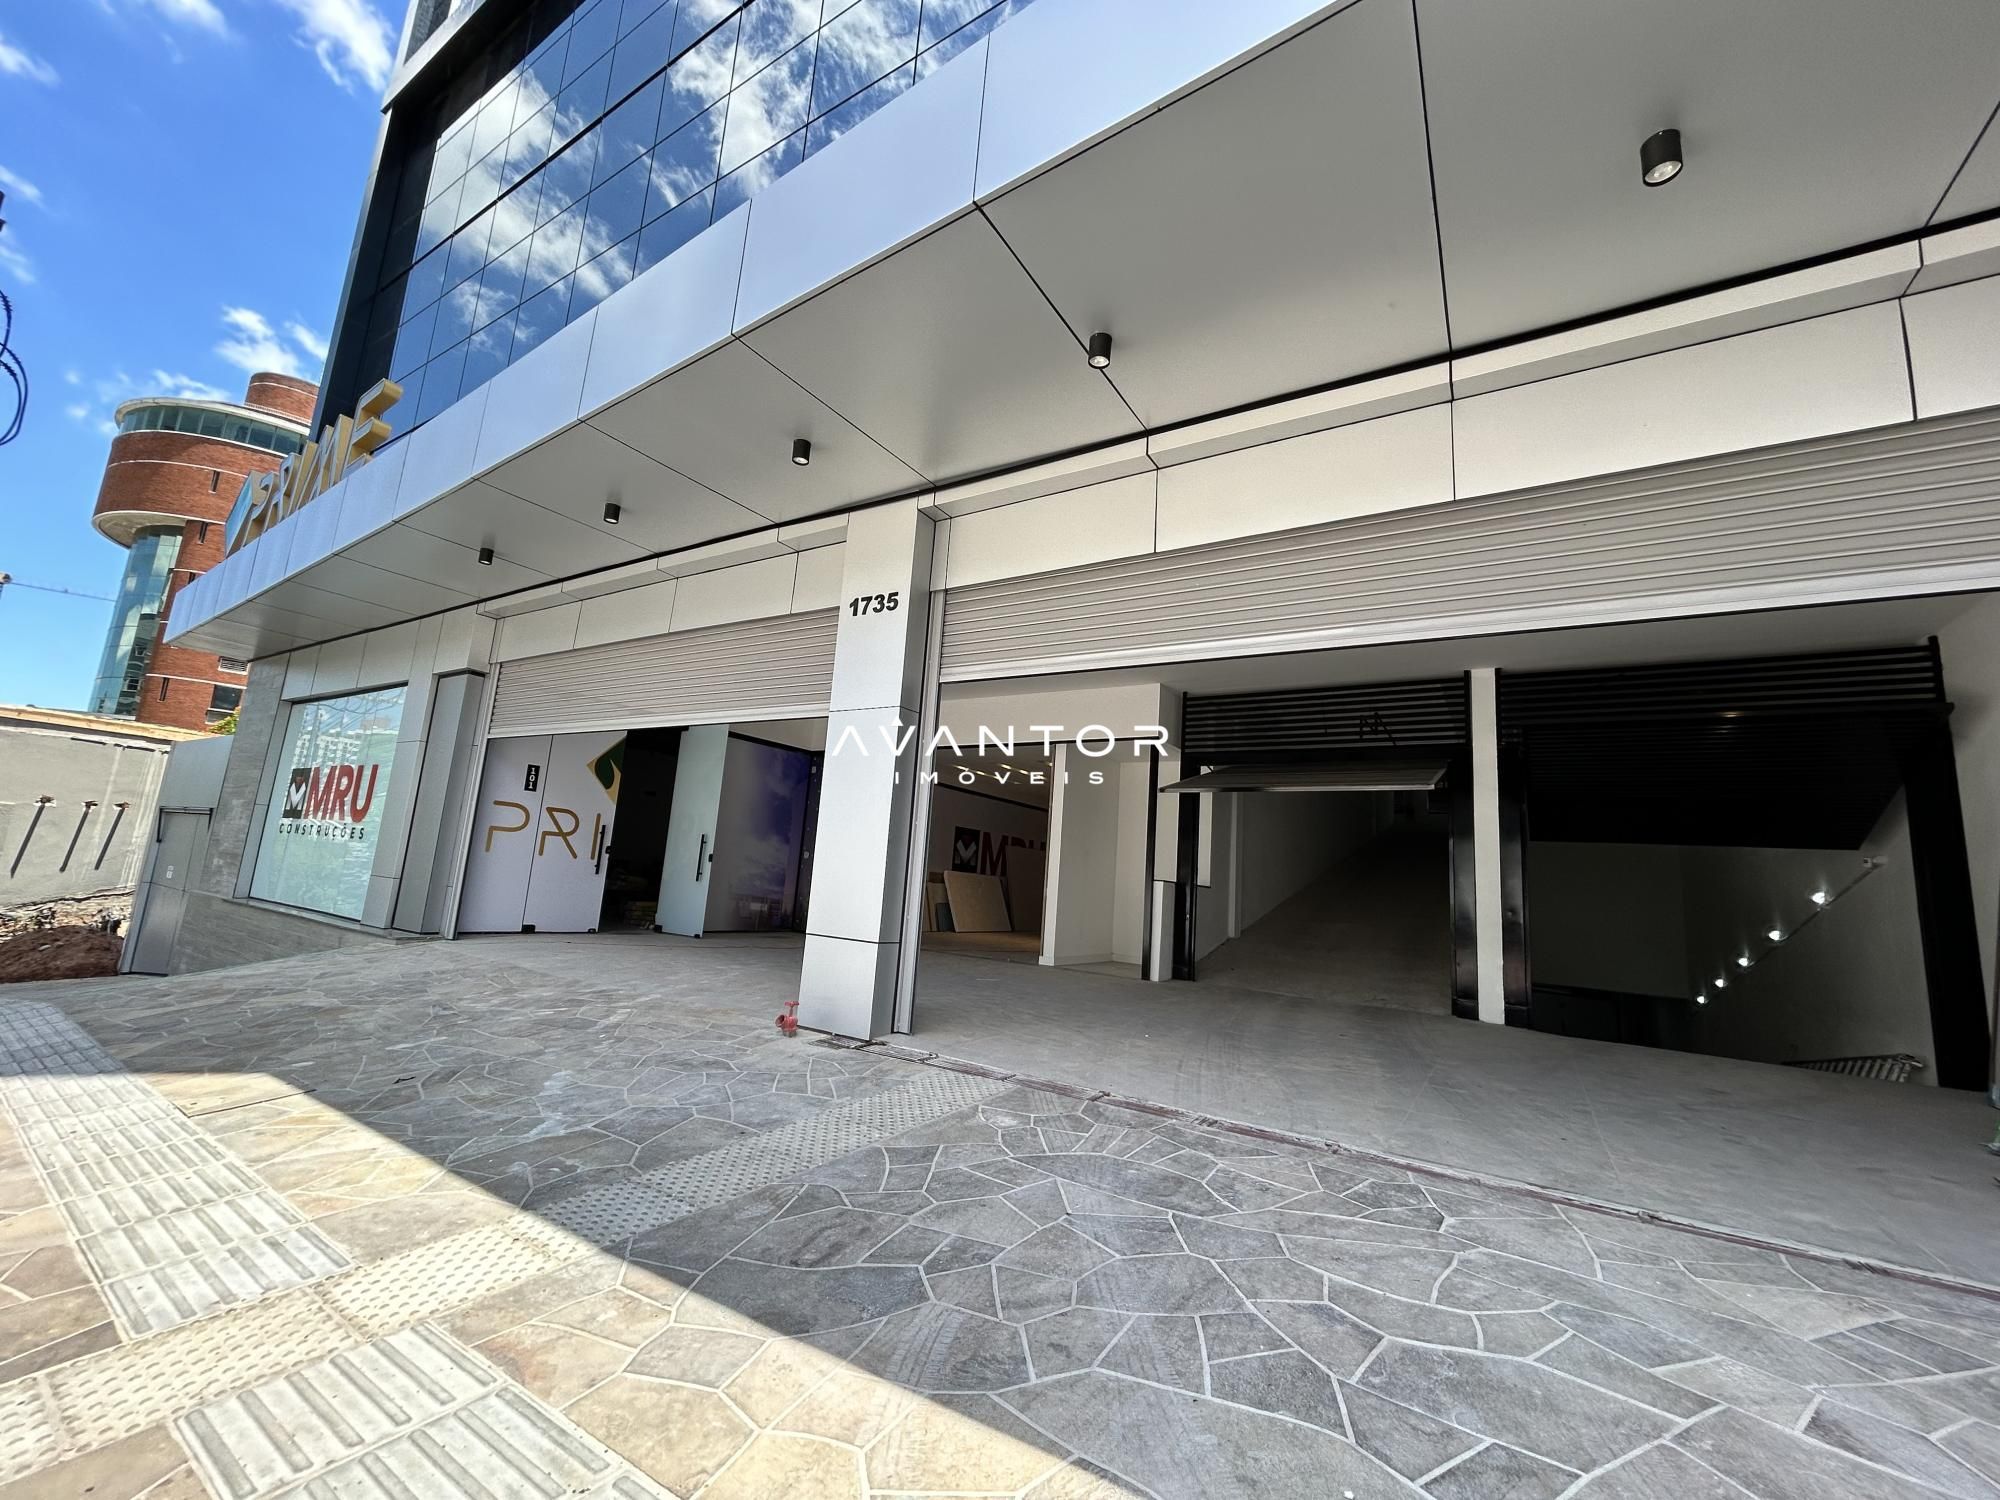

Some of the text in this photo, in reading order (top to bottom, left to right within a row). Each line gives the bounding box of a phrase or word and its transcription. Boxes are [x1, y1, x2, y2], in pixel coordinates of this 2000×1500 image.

[849, 592, 900, 616] 1735
[304, 764, 379, 822] MRU
[279, 823, 365, 841] CONSTRUÇÕES
[486, 800, 601, 860] PRI
